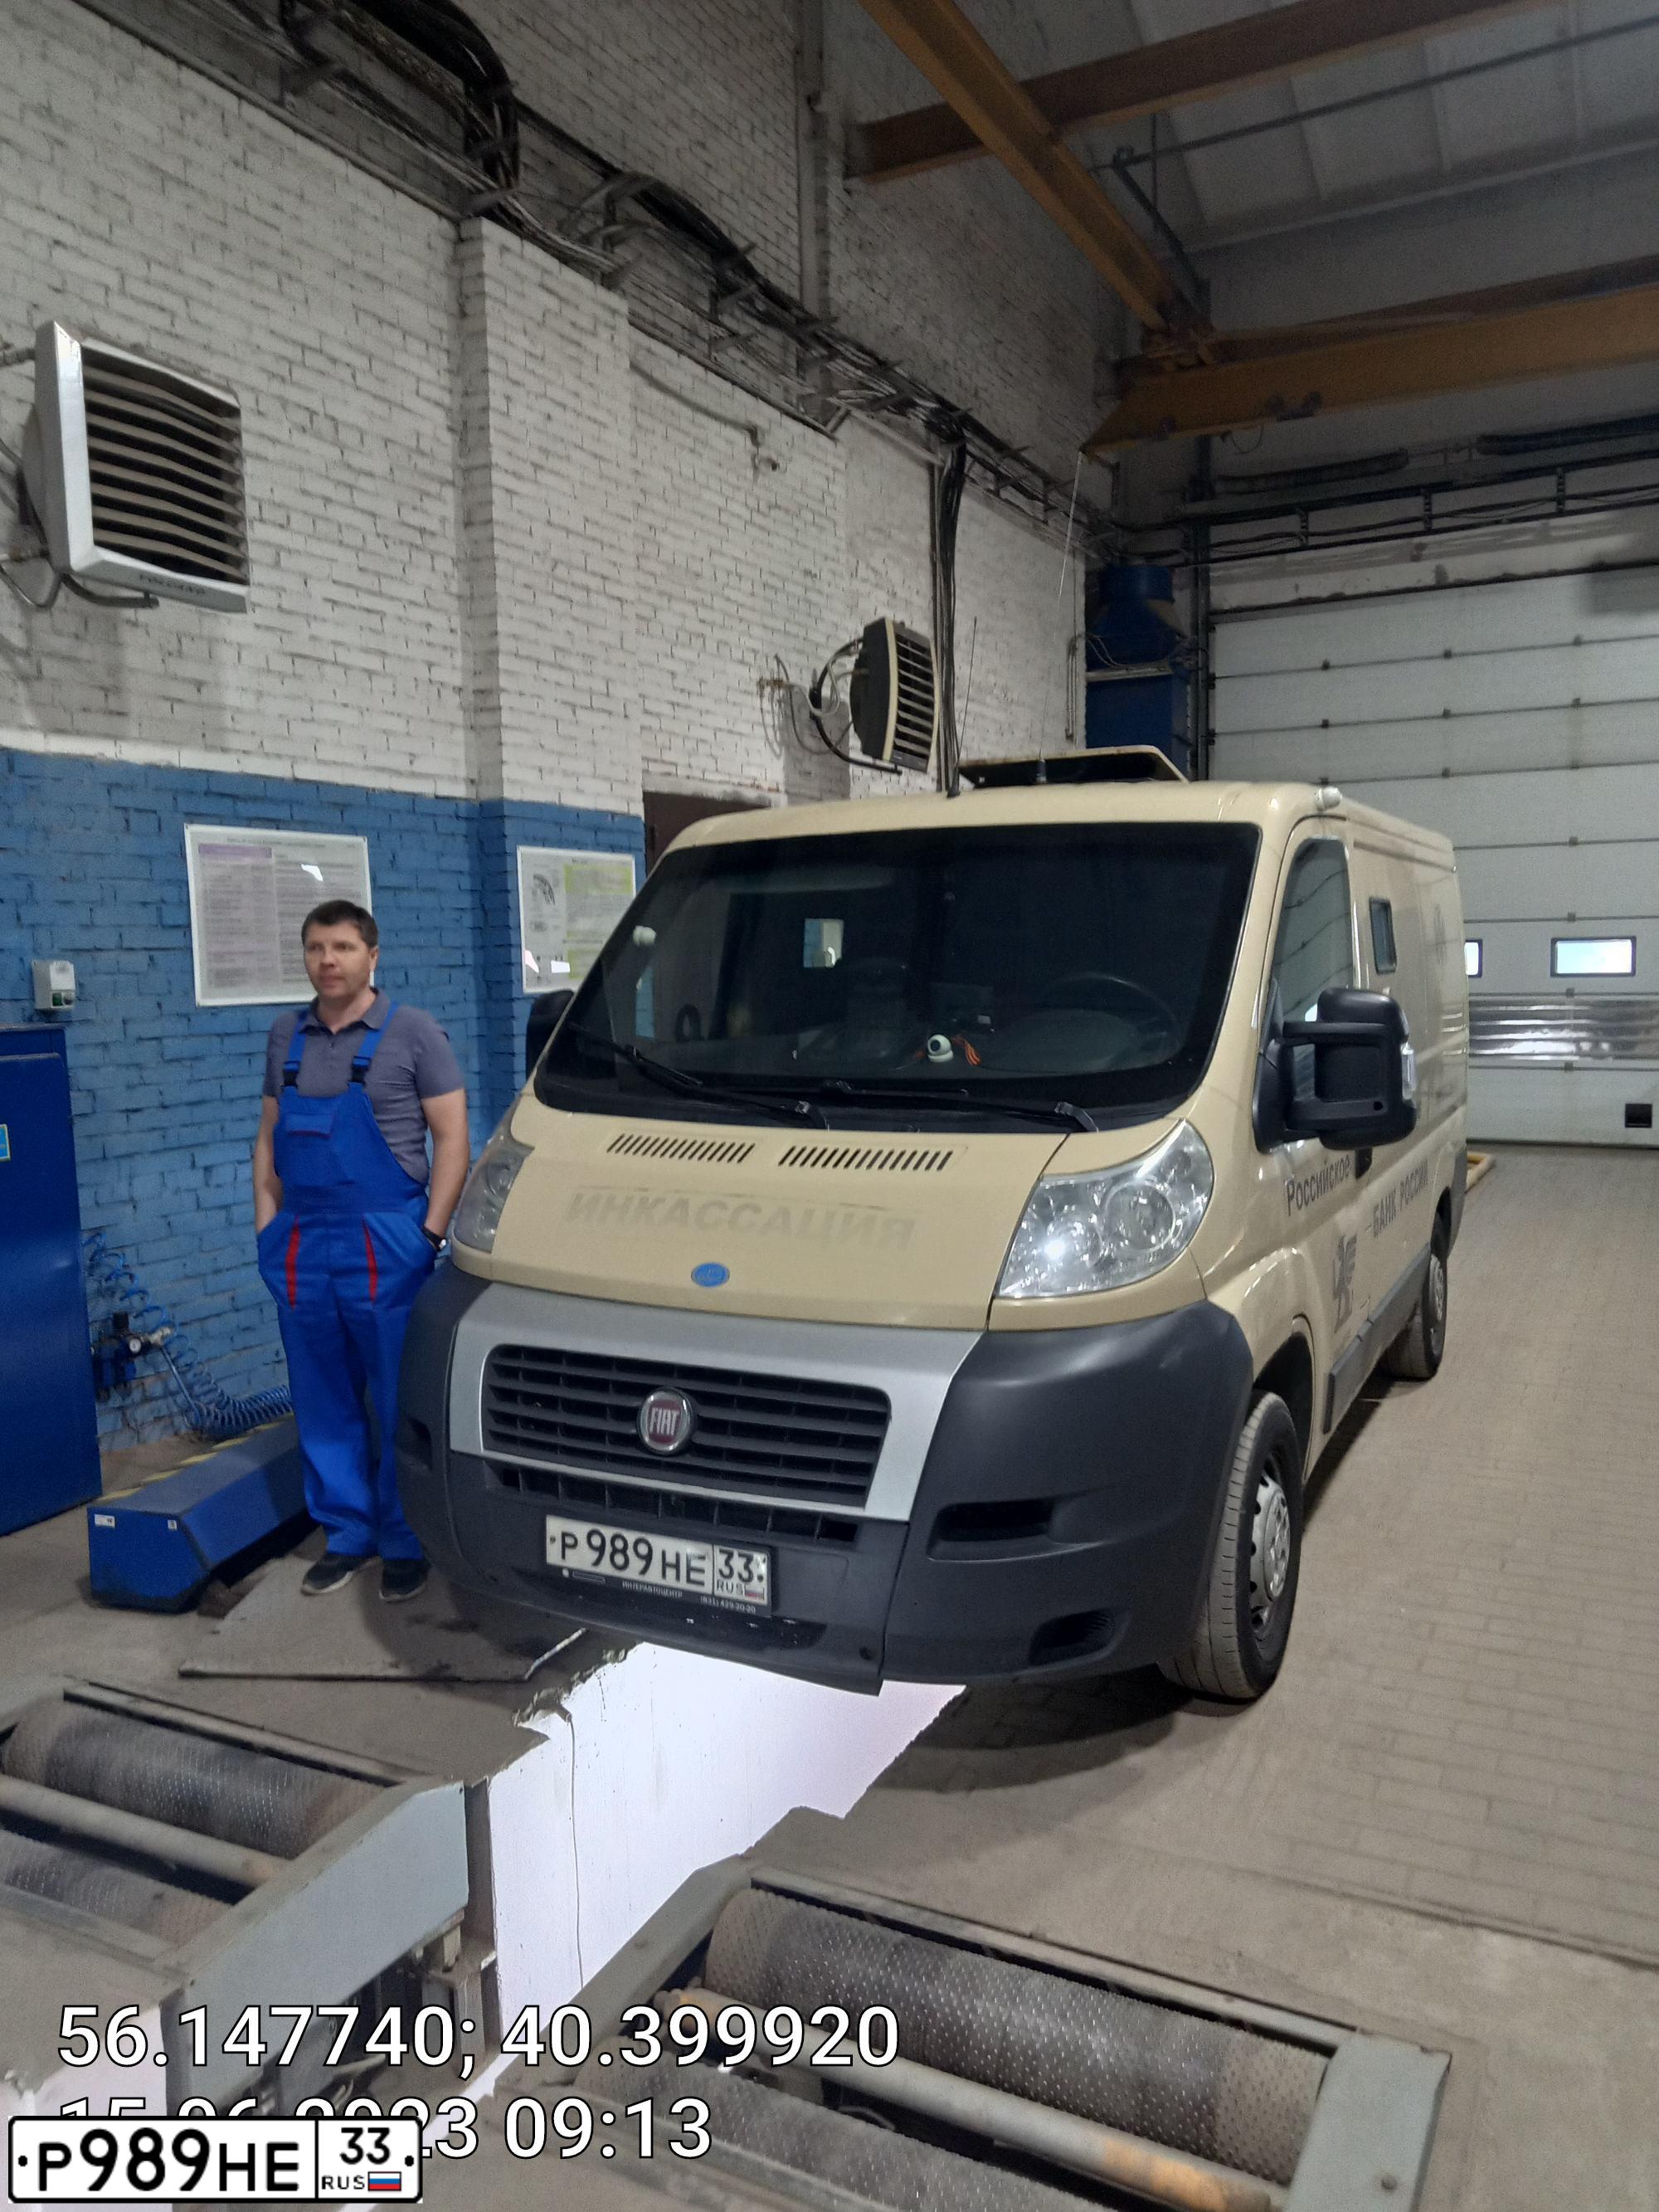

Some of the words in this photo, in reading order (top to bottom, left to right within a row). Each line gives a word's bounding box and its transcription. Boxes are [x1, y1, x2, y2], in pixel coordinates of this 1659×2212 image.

[1287, 1153, 1350, 1217] Российское
[563, 1191, 916, 1250] ИНКАССАЦИЯ
[1373, 1186, 1397, 1238] БАНК
[649, 1406, 680, 1436] FIAT
[560, 1528, 707, 1586] Р989НЕ
[718, 1549, 755, 1583] 33
[716, 1579, 743, 1596] RUS
